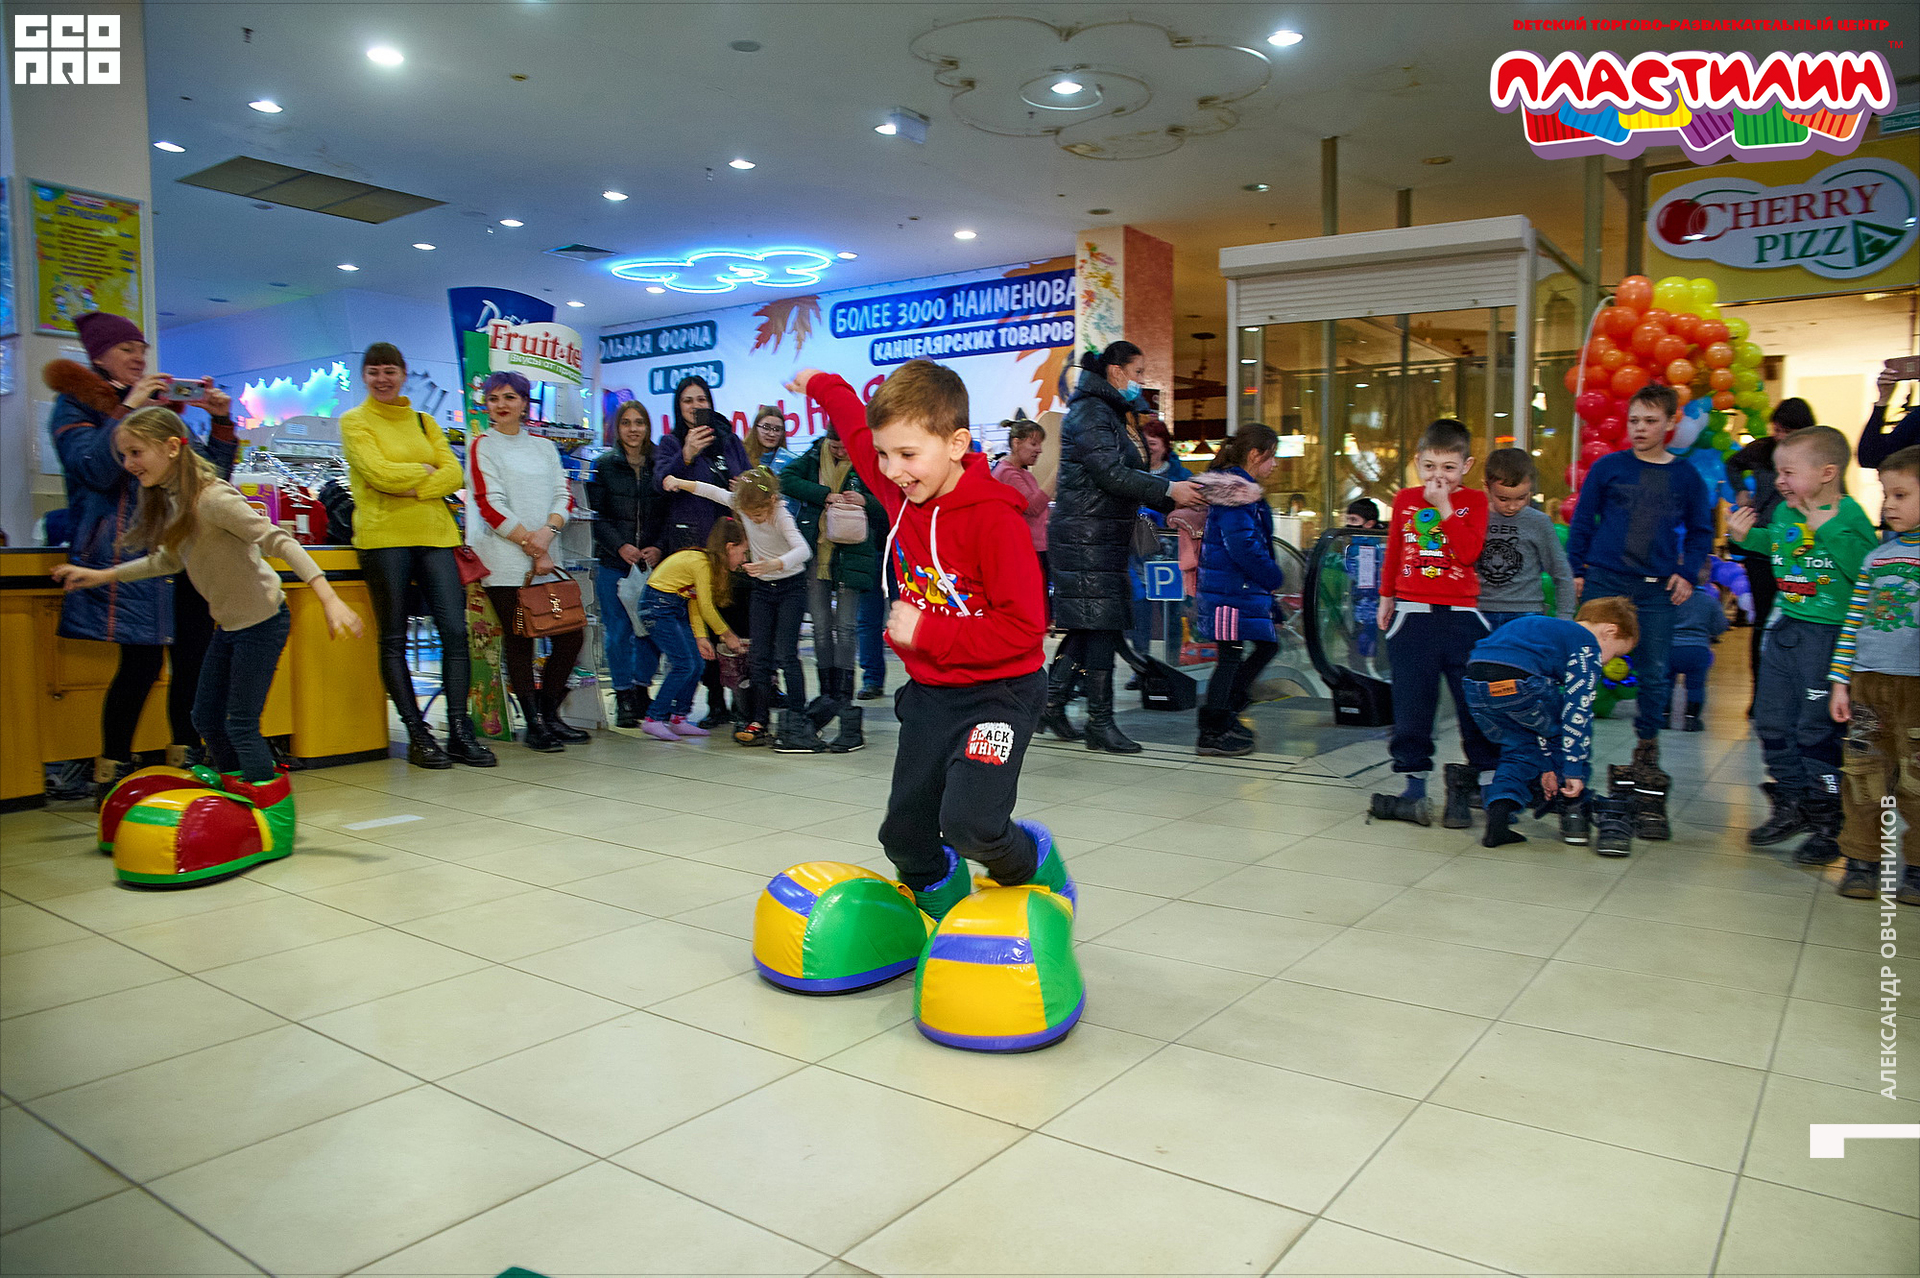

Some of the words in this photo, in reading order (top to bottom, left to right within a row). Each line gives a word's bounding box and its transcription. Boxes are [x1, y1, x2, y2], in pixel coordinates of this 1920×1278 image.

[1688, 183, 1883, 242] CHERRY
[836, 302, 892, 333] БОЛЕЕ
[898, 298, 947, 325] 3000
[658, 325, 712, 351] ФОРМА
[873, 328, 996, 361] КАНЦЕЛЯРСКИХ
[998, 320, 1075, 347] ТОВАРОВ
[1489, 525, 1518, 534] GER
[1804, 557, 1833, 569] Tok
[1155, 567, 1175, 595] P
[971, 730, 1009, 743] BLACK
